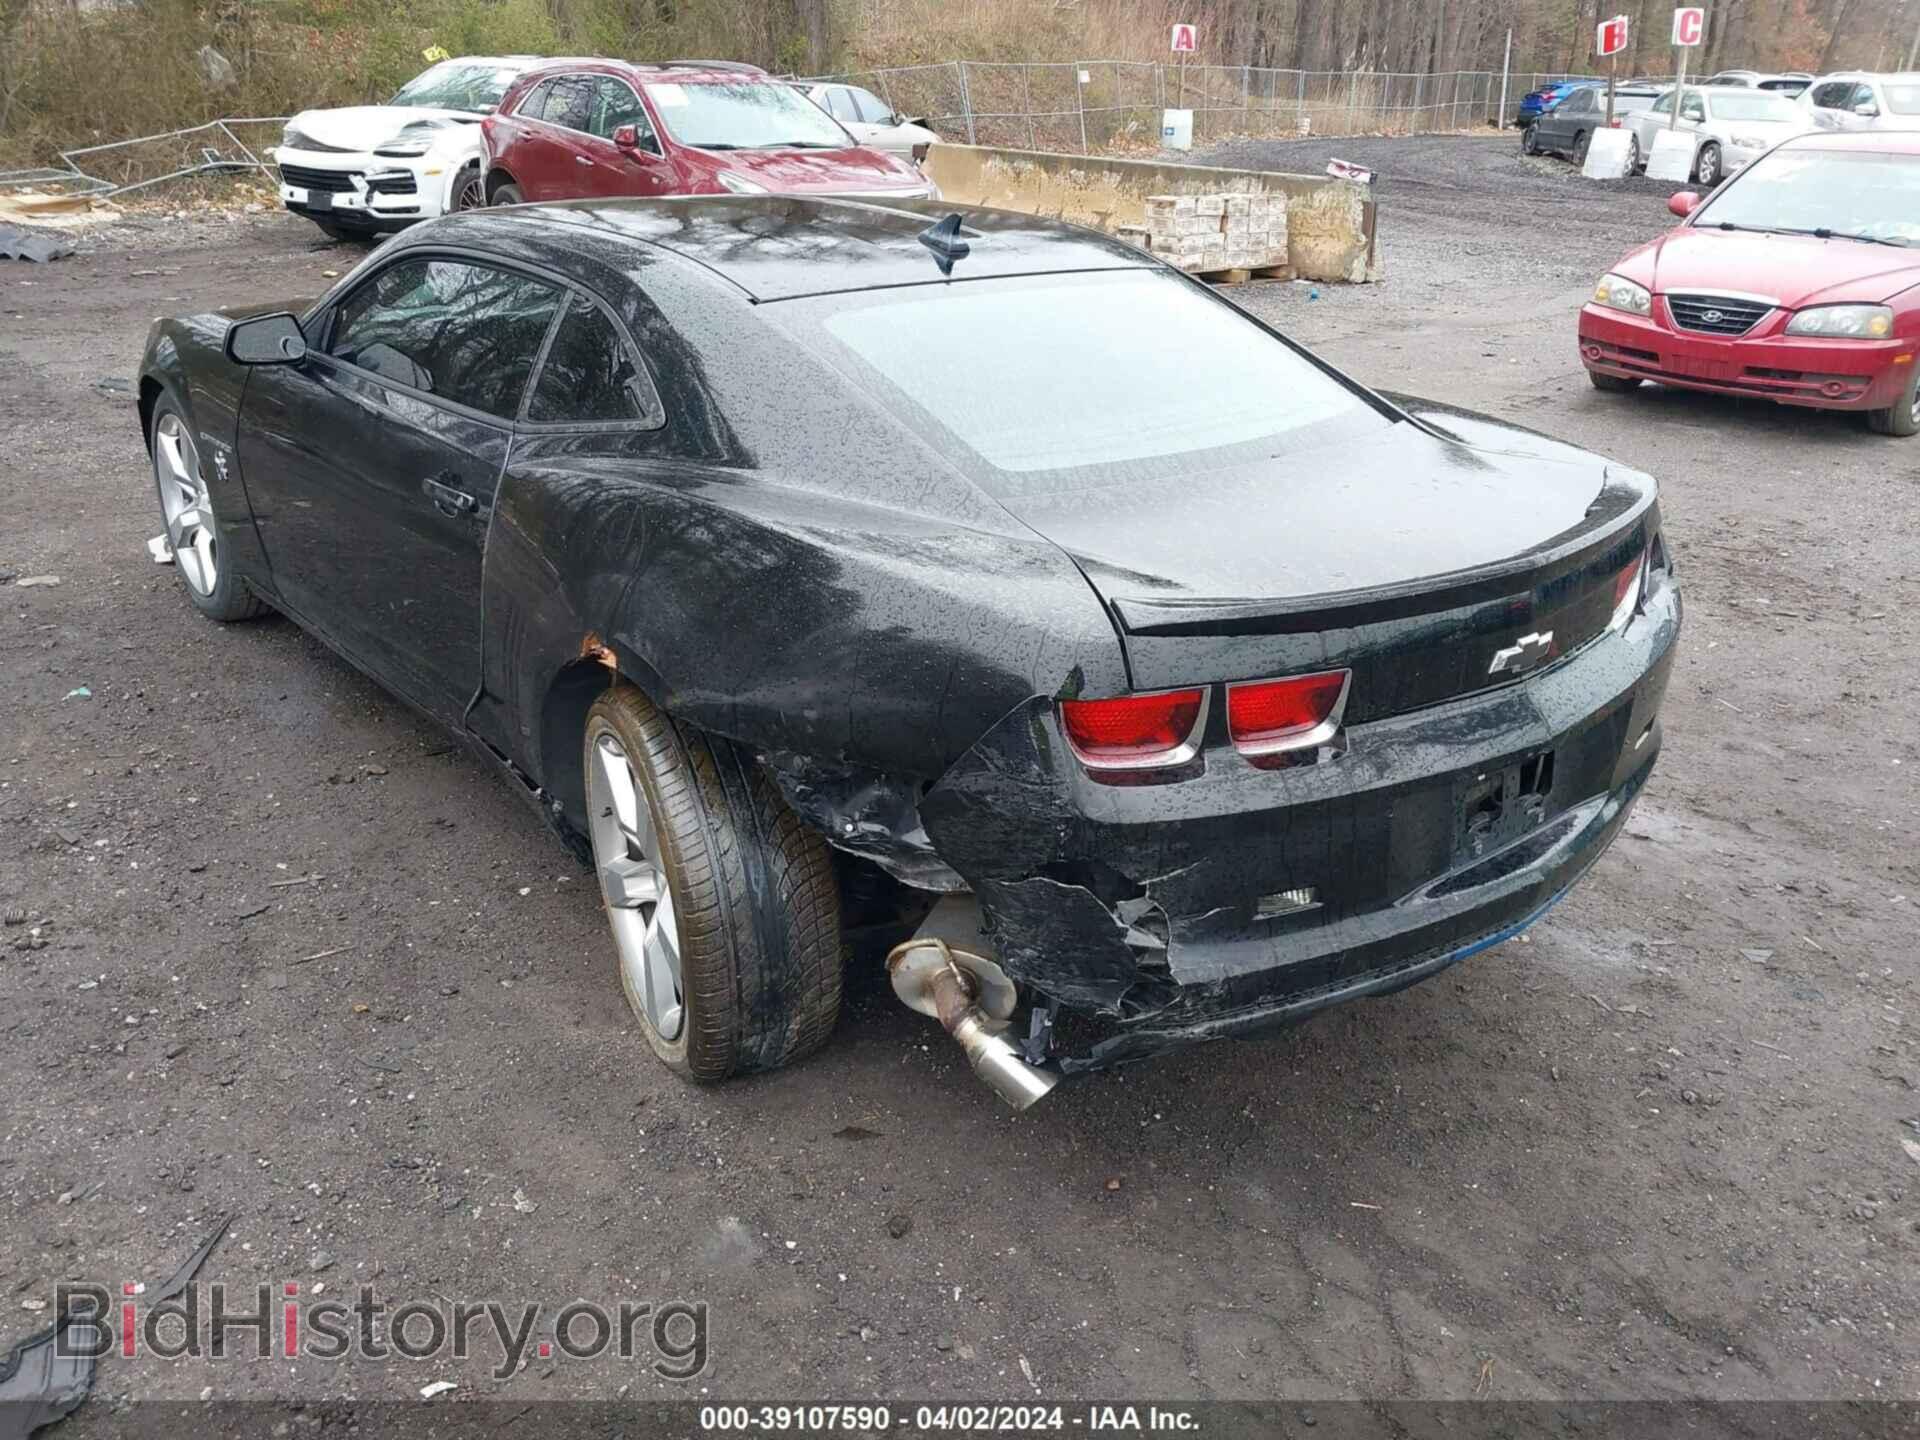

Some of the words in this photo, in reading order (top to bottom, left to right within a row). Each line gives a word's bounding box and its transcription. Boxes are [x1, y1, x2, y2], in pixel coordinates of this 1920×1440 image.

[1176, 26, 1193, 49] A
[1604, 21, 1626, 53] B
[1680, 10, 1701, 43] C
